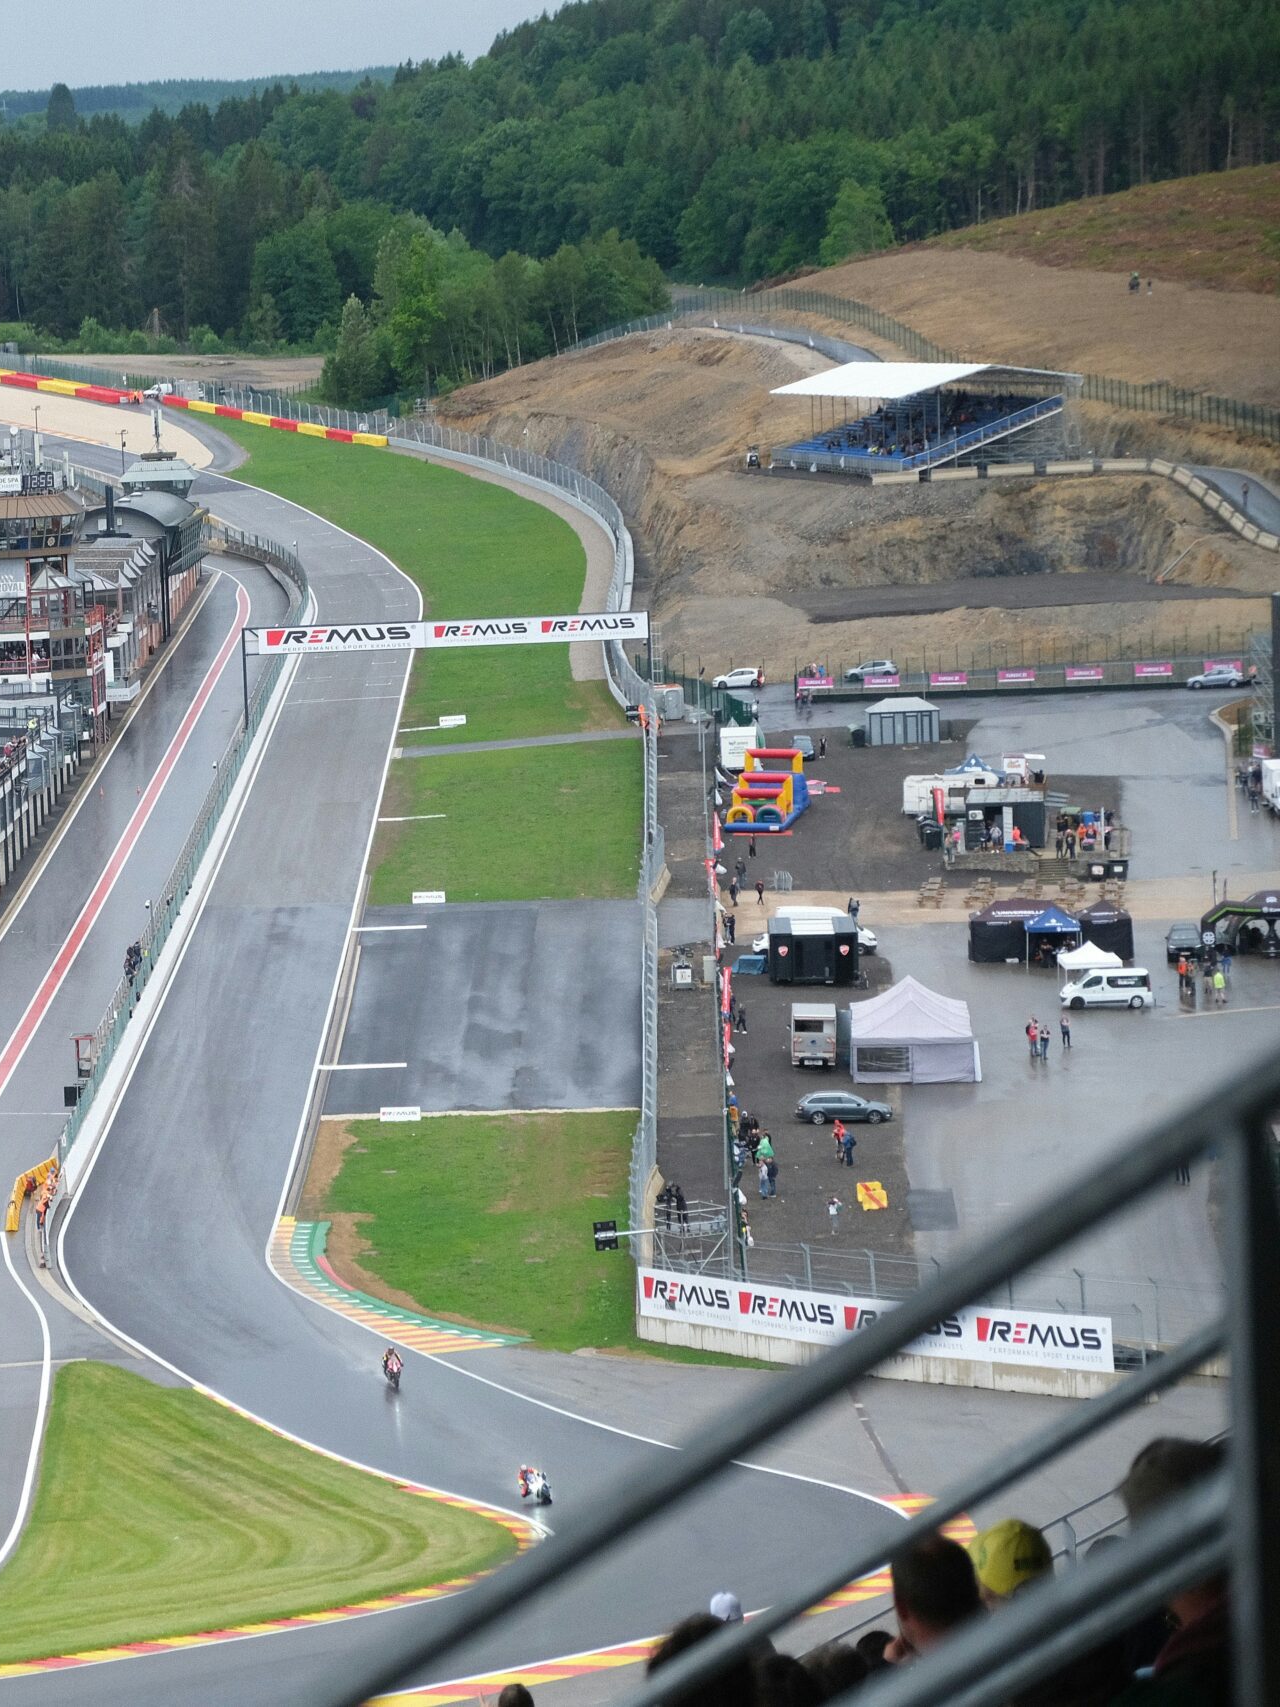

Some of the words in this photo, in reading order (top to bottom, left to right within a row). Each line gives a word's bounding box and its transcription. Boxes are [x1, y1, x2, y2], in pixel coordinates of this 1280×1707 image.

[444, 622, 528, 637] REMUS
[551, 617, 636, 632] REMUS
[282, 625, 412, 645] REMUS
[653, 1279, 731, 1310] REMUS
[751, 1295, 835, 1326] REMUS
[989, 1320, 1102, 1350] REMUS
[1042, 1351, 1063, 1361] SPORT
[1066, 1353, 1104, 1364] EXHAUSTS
